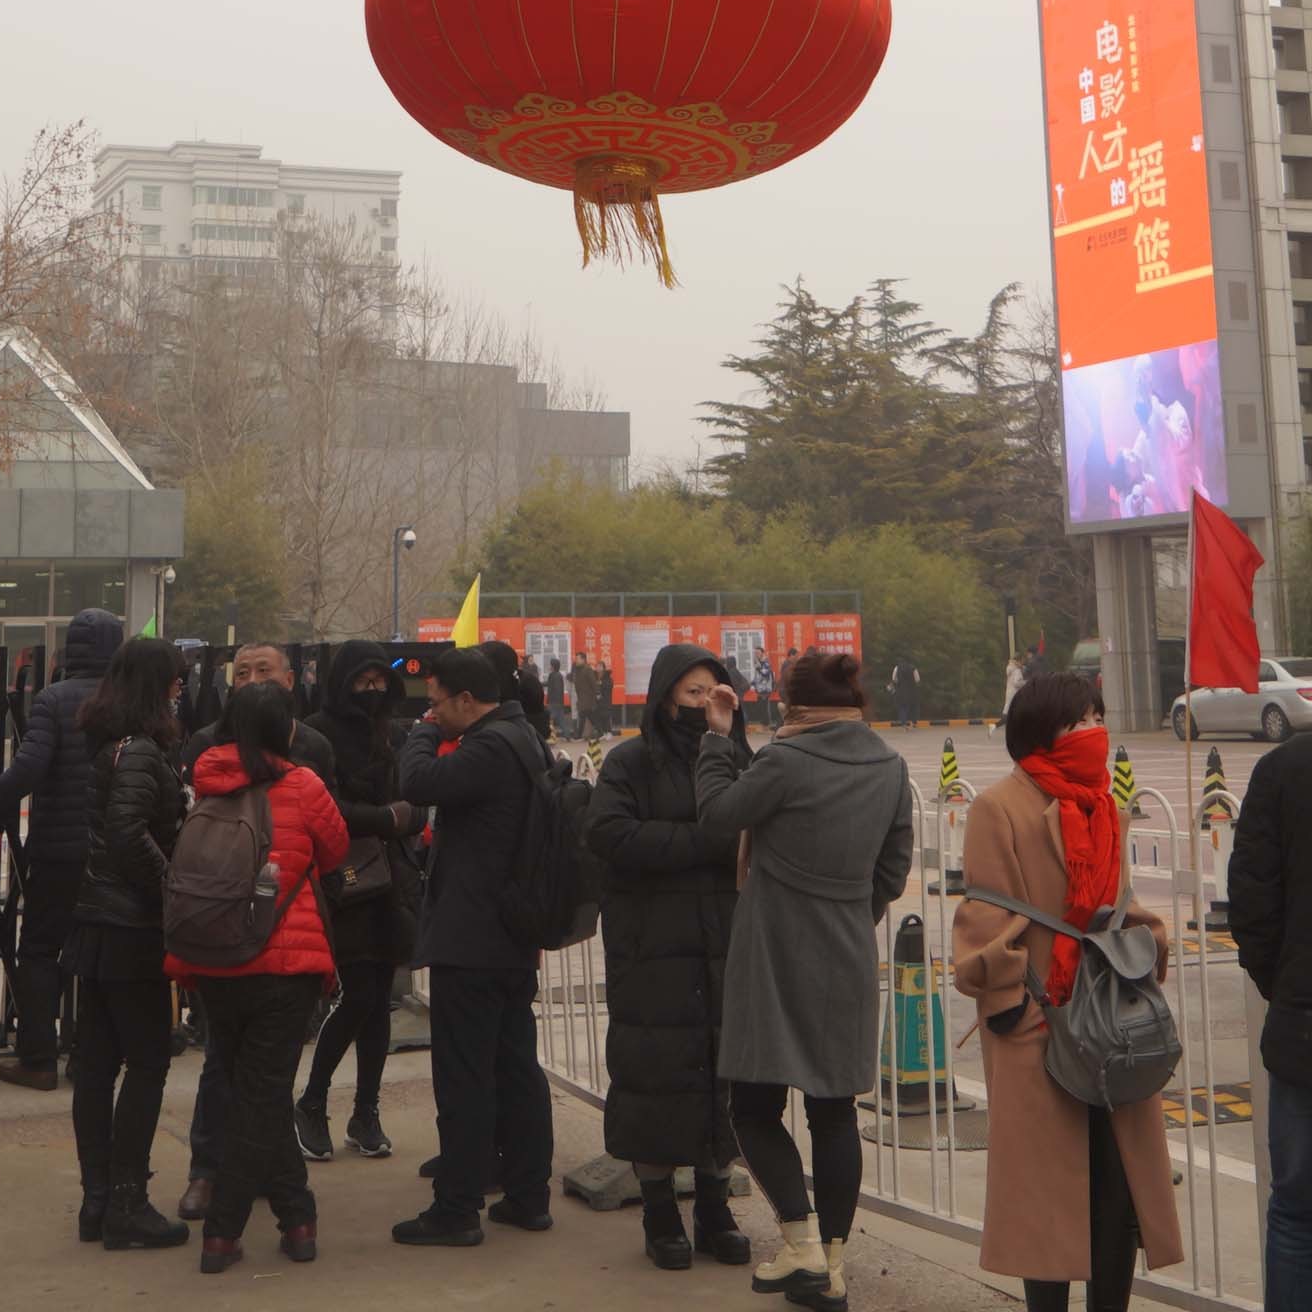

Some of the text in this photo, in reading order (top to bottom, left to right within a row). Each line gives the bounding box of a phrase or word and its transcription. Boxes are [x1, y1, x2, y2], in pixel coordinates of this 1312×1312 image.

[1078, 67, 1096, 125] 中国
[1110, 177, 1126, 207] 的
[1128, 141, 1170, 283] 摇篮
